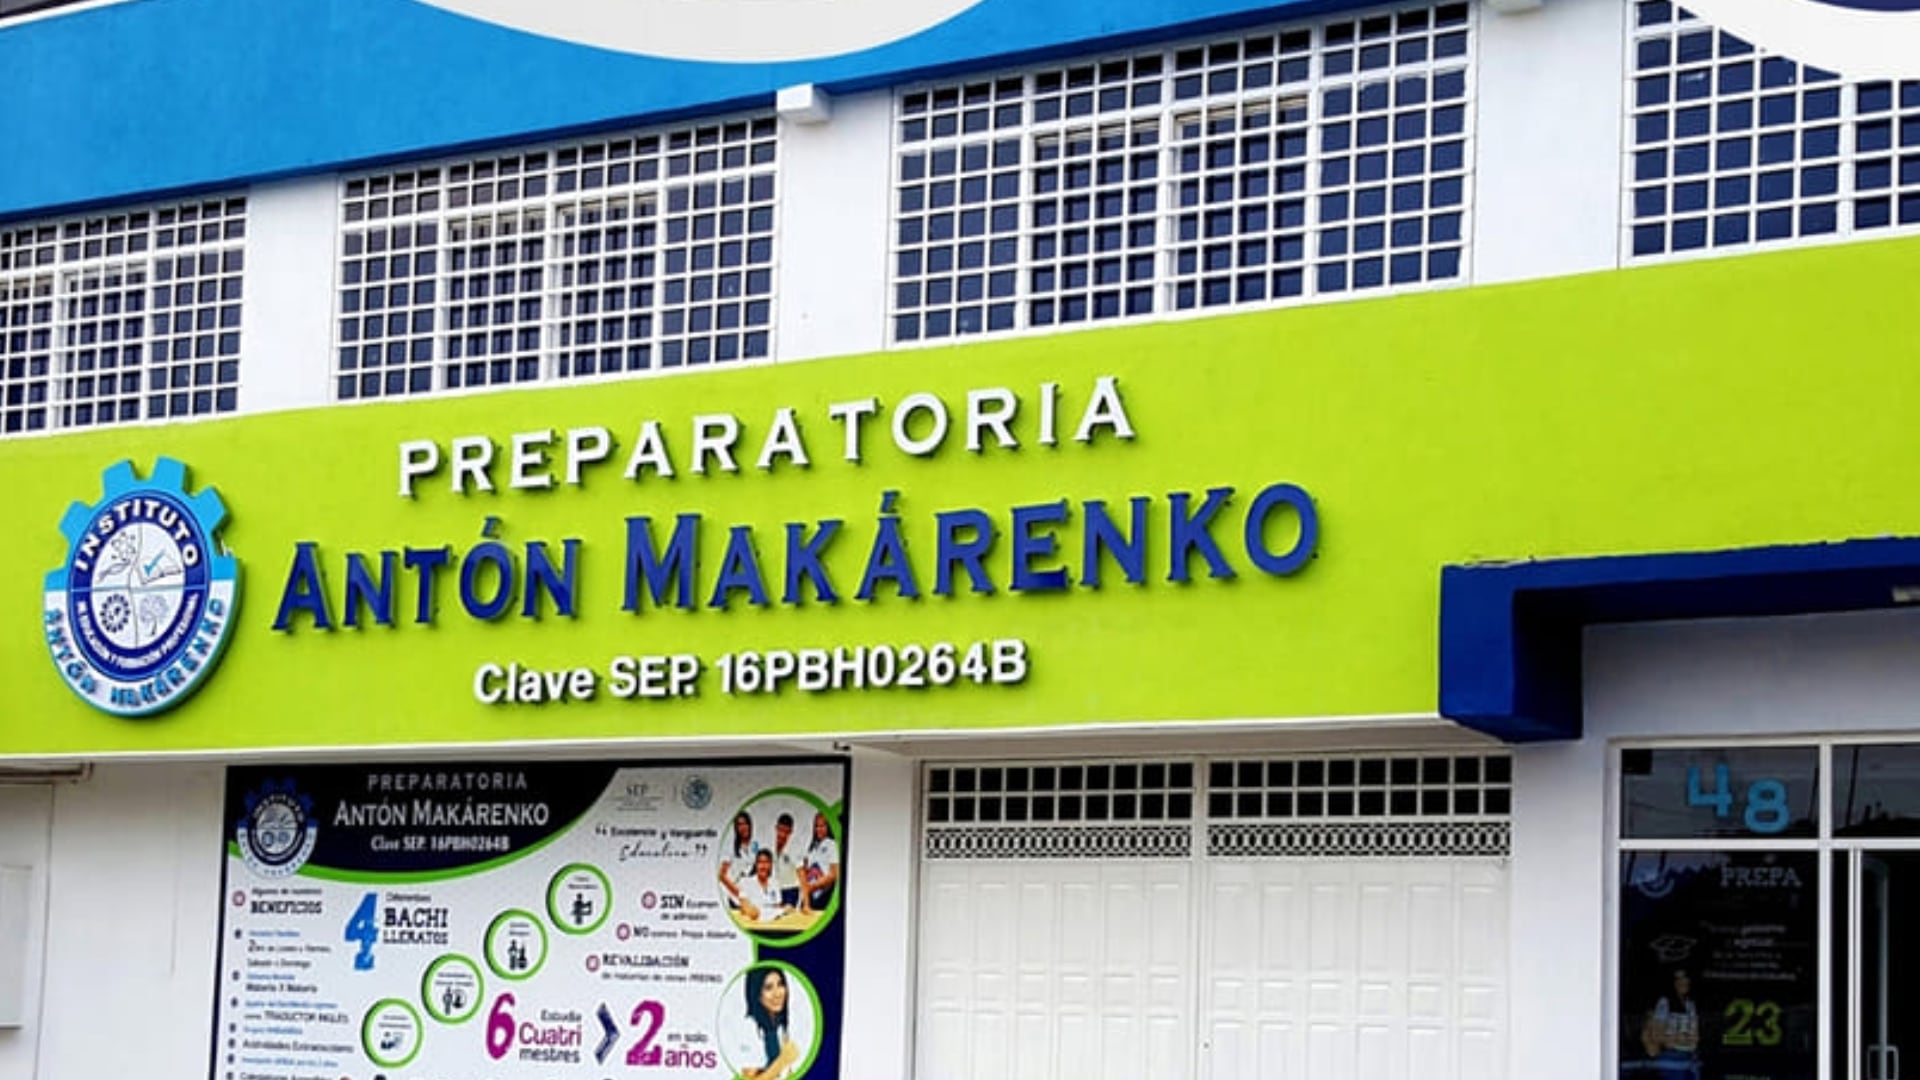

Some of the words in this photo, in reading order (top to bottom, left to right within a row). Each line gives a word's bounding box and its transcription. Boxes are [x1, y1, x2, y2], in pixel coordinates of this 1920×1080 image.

[398, 376, 1137, 498] PREPARATORIA
[74, 498, 200, 573] INSTITUTO
[271, 515, 584, 632] ANTÓN
[621, 483, 1322, 612] MAKÁRENKO
[473, 662, 597, 704] Clave
[715, 638, 1028, 695] 16PBH0264B
[367, 772, 528, 791] PREPARATORIA
[333, 796, 406, 827] ANTÓN
[411, 796, 550, 827] MAKÁRENKO
[1687, 762, 1790, 834] 48
[1719, 865, 1803, 888] PREPA
[250, 900, 323, 915] BENEFICIOS
[660, 894, 685, 909] SIN
[344, 891, 379, 971] 4
[383, 907, 450, 928] BACHI
[602, 953, 691, 968] REVALIDACIÓN
[485, 992, 517, 1061] 6
[518, 1022, 583, 1046] Cuatri
[625, 999, 666, 1067] 2
[1722, 999, 1783, 1045] 23
[518, 1048, 581, 1064] mestres
[664, 1043, 718, 1069] años
